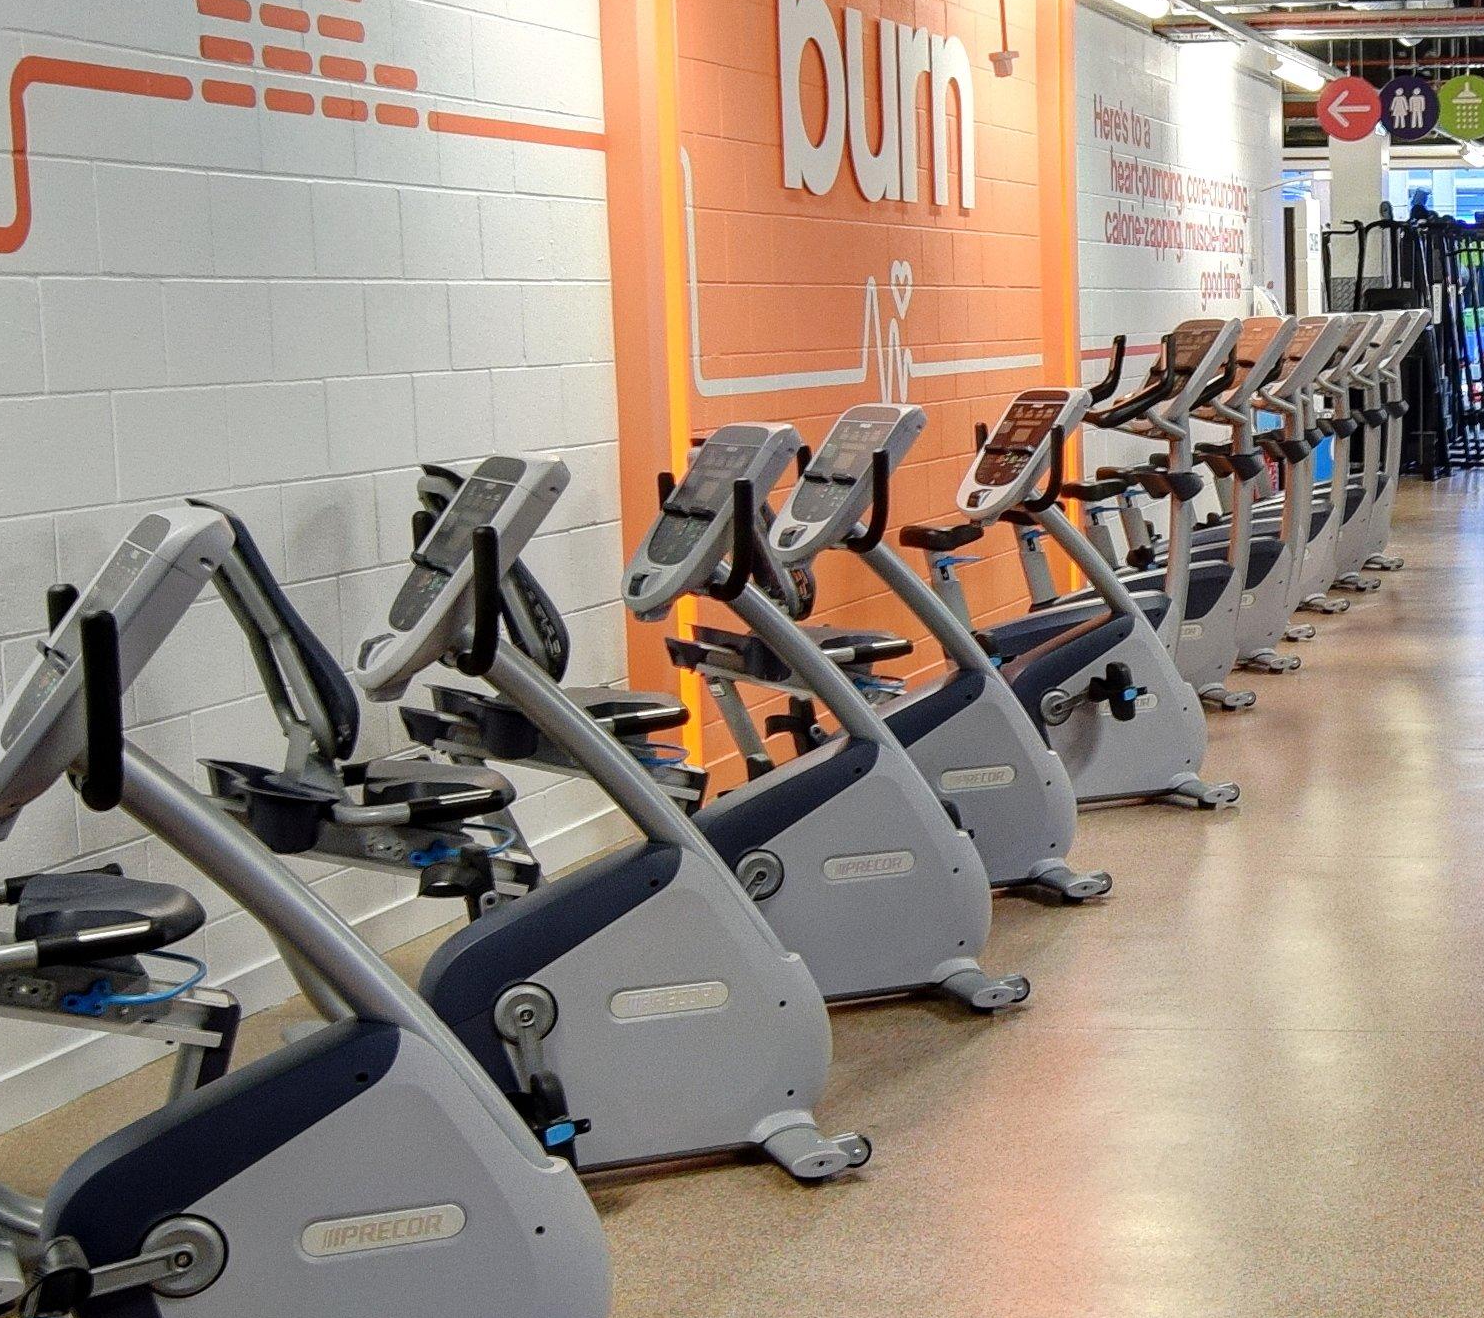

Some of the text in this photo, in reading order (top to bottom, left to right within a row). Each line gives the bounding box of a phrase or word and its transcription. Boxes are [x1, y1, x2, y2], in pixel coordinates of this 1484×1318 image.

[1093, 93, 1151, 149] Here's to a
[1200, 260, 1223, 312] good
[337, 1213, 445, 1248] PRECOR
